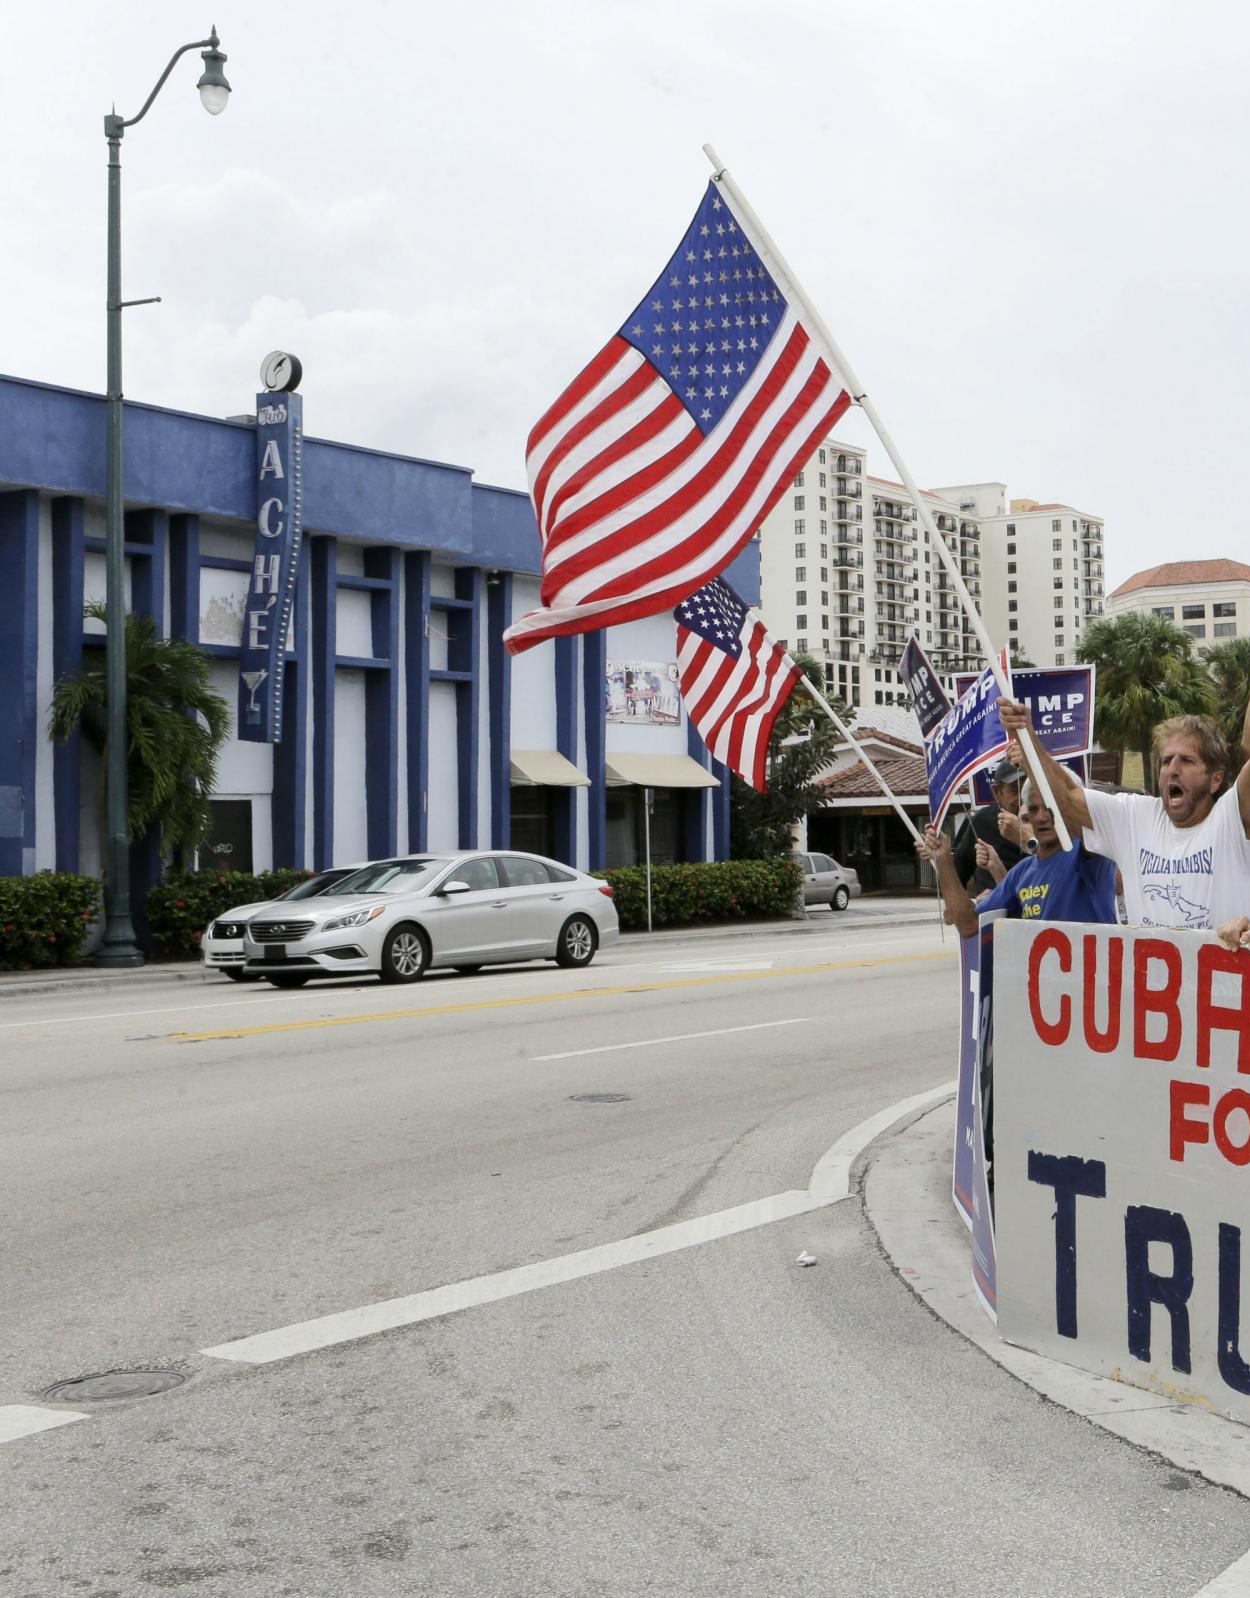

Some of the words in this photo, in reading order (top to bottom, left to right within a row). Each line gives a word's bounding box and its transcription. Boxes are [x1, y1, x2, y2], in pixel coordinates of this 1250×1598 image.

[927, 674, 995, 766] TRUMP
[956, 720, 972, 743] GREAT
[973, 701, 997, 726] AGAIN!
[1052, 725, 1077, 734] AGAIN!
